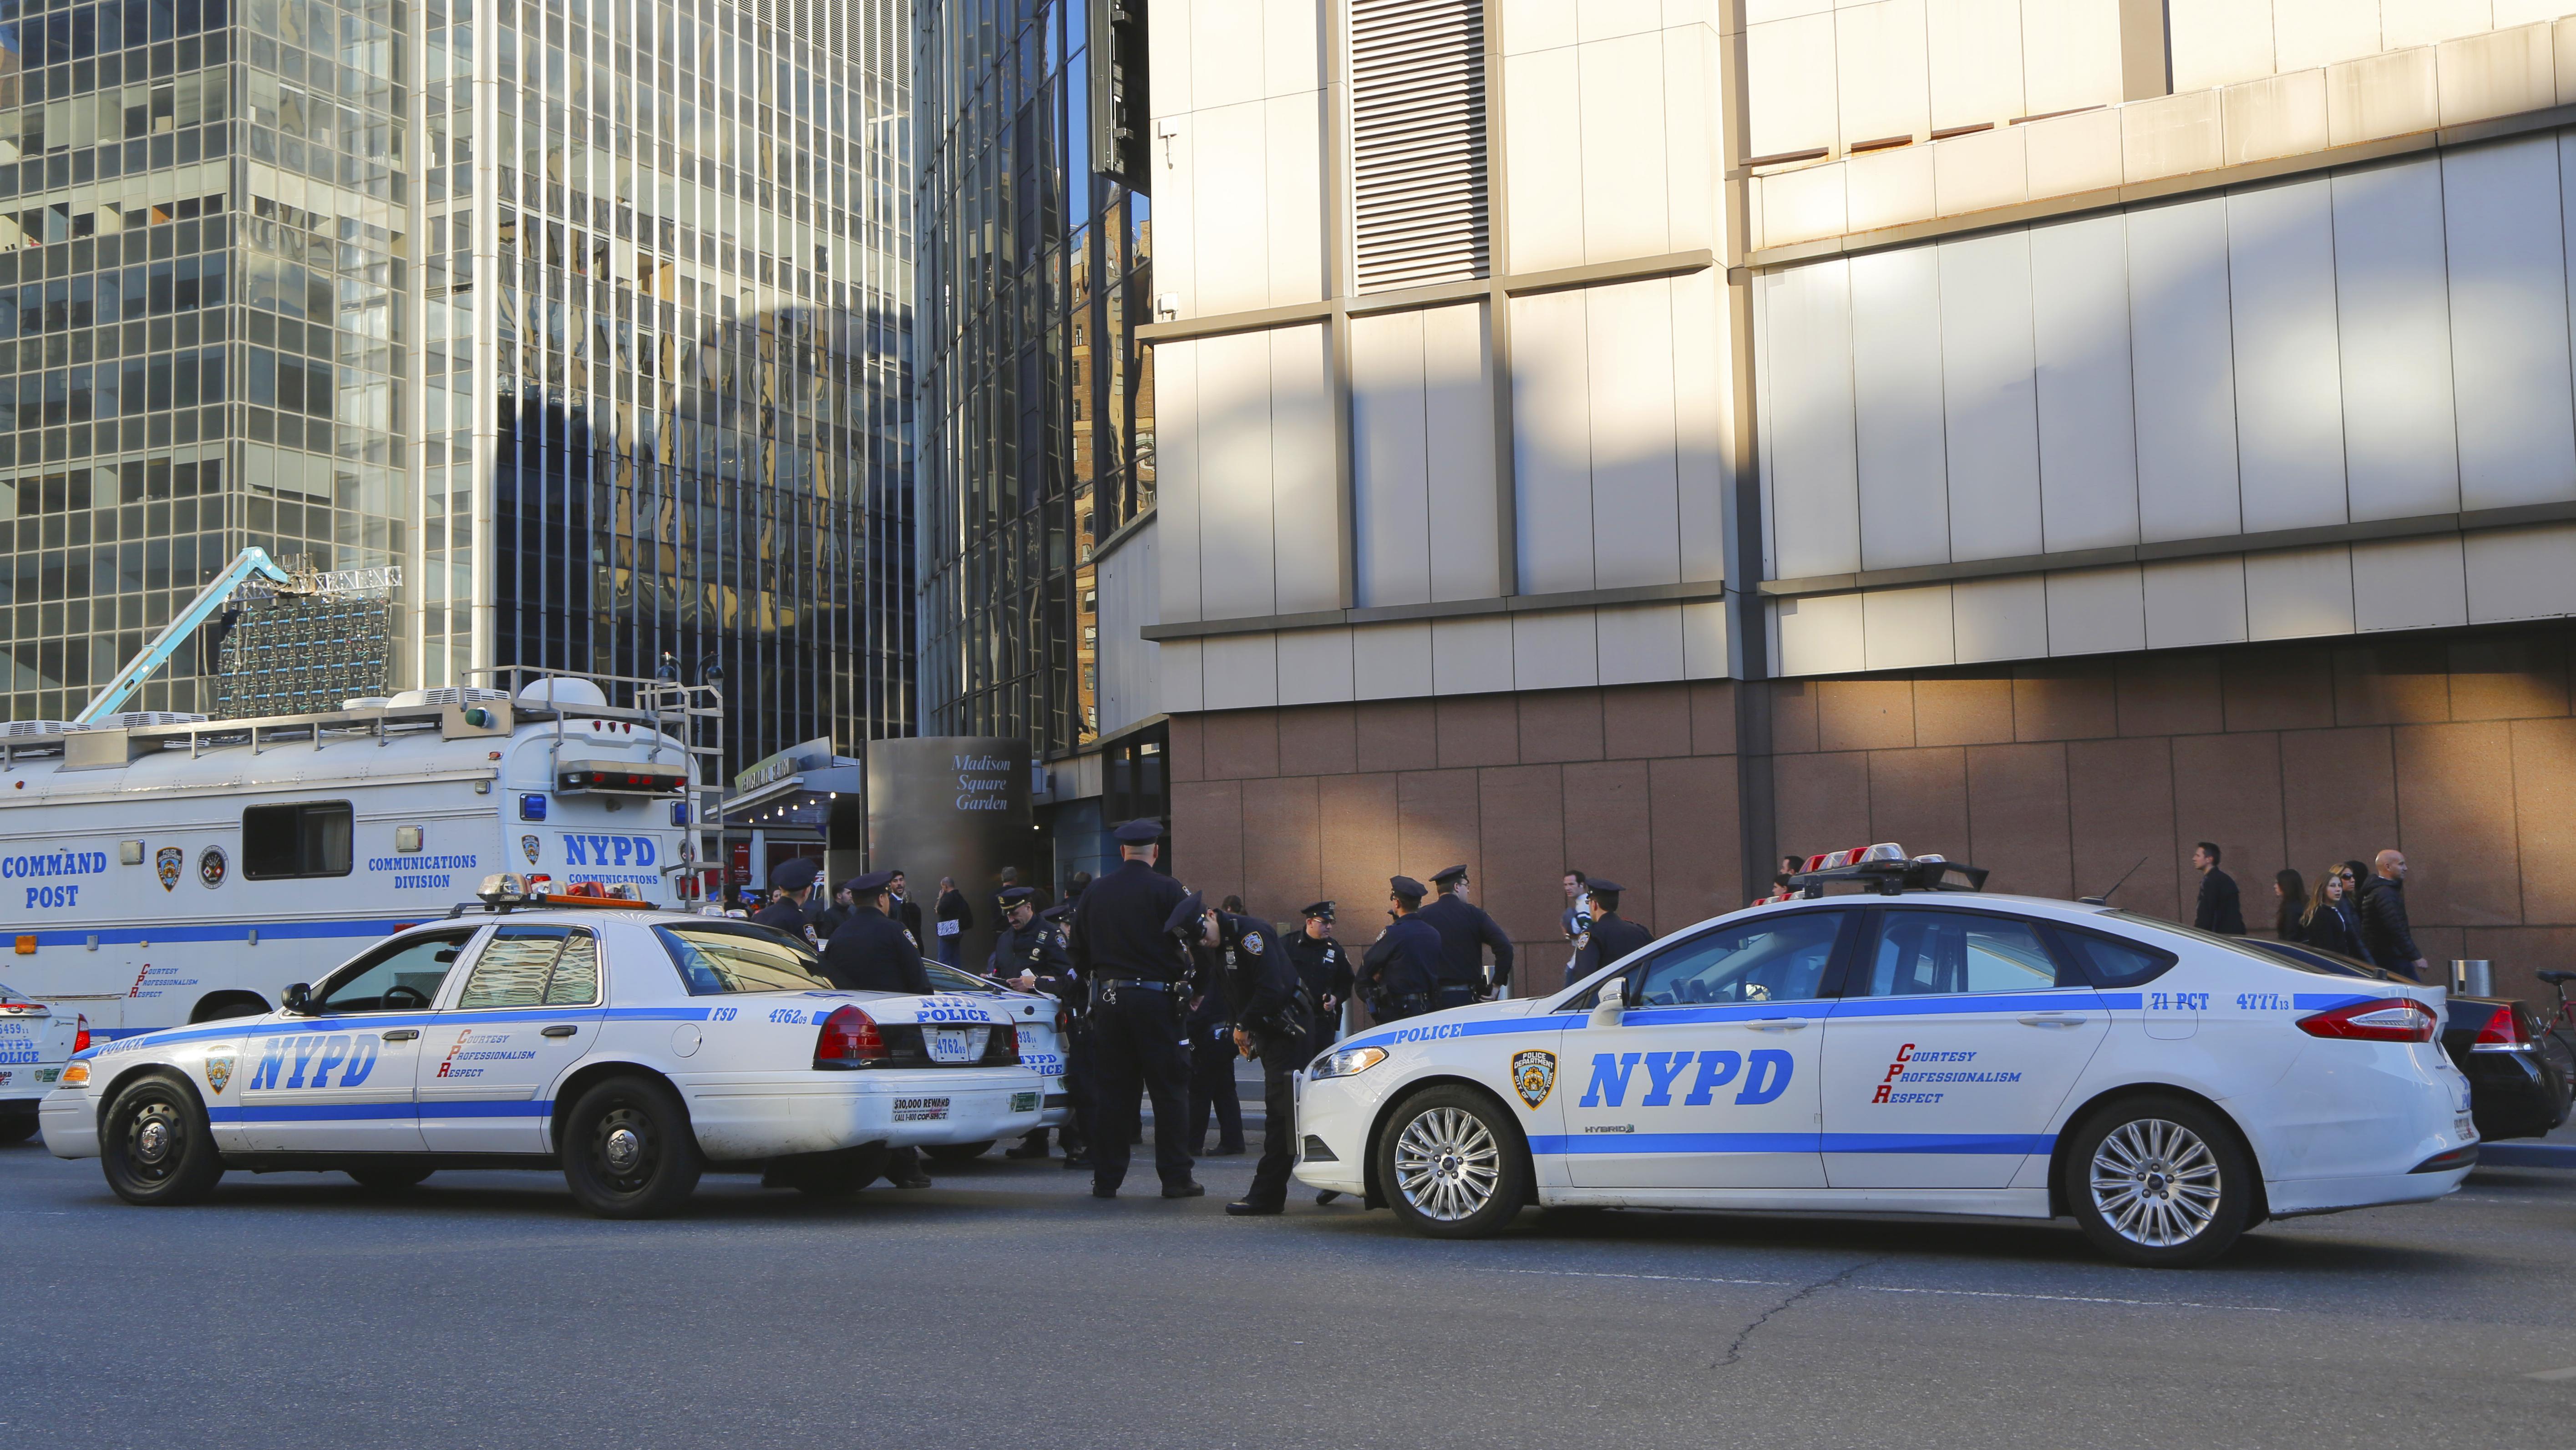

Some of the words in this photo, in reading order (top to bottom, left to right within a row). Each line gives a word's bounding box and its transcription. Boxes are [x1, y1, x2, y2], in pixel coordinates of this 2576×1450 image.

[951, 755, 1010, 771] Madison
[957, 774, 1006, 793] Square
[956, 794, 1007, 810] Garden
[158, 854, 181, 862] DEPARTMENT
[563, 834, 655, 866] NYPD
[2, 852, 106, 878] COMMAND
[369, 855, 477, 871] COMMUNICATIONS
[395, 875, 450, 888] DIVISION
[569, 874, 658, 885] COMMUNICATIONS
[26, 885, 78, 908] POST
[918, 997, 976, 1008] NYPD
[2151, 993, 2167, 1009] 71
[2176, 993, 2209, 1010] PCT
[713, 1008, 738, 1021] FSD
[914, 1009, 990, 1023] POLICE
[1395, 1023, 1462, 1044] POLICE
[99, 1037, 146, 1055] POLICE
[250, 1034, 380, 1090] NYPD
[1514, 1058, 1554, 1069] DEPARTMENT
[1514, 1075, 1523, 1090] CITY
[1579, 1049, 1794, 1107] NYPD
[1537, 1089, 1547, 1102] NEW
[1545, 1072, 1553, 1088] YORK
[894, 1098, 922, 1110] $10,000
[923, 1098, 950, 1108] REWARD
